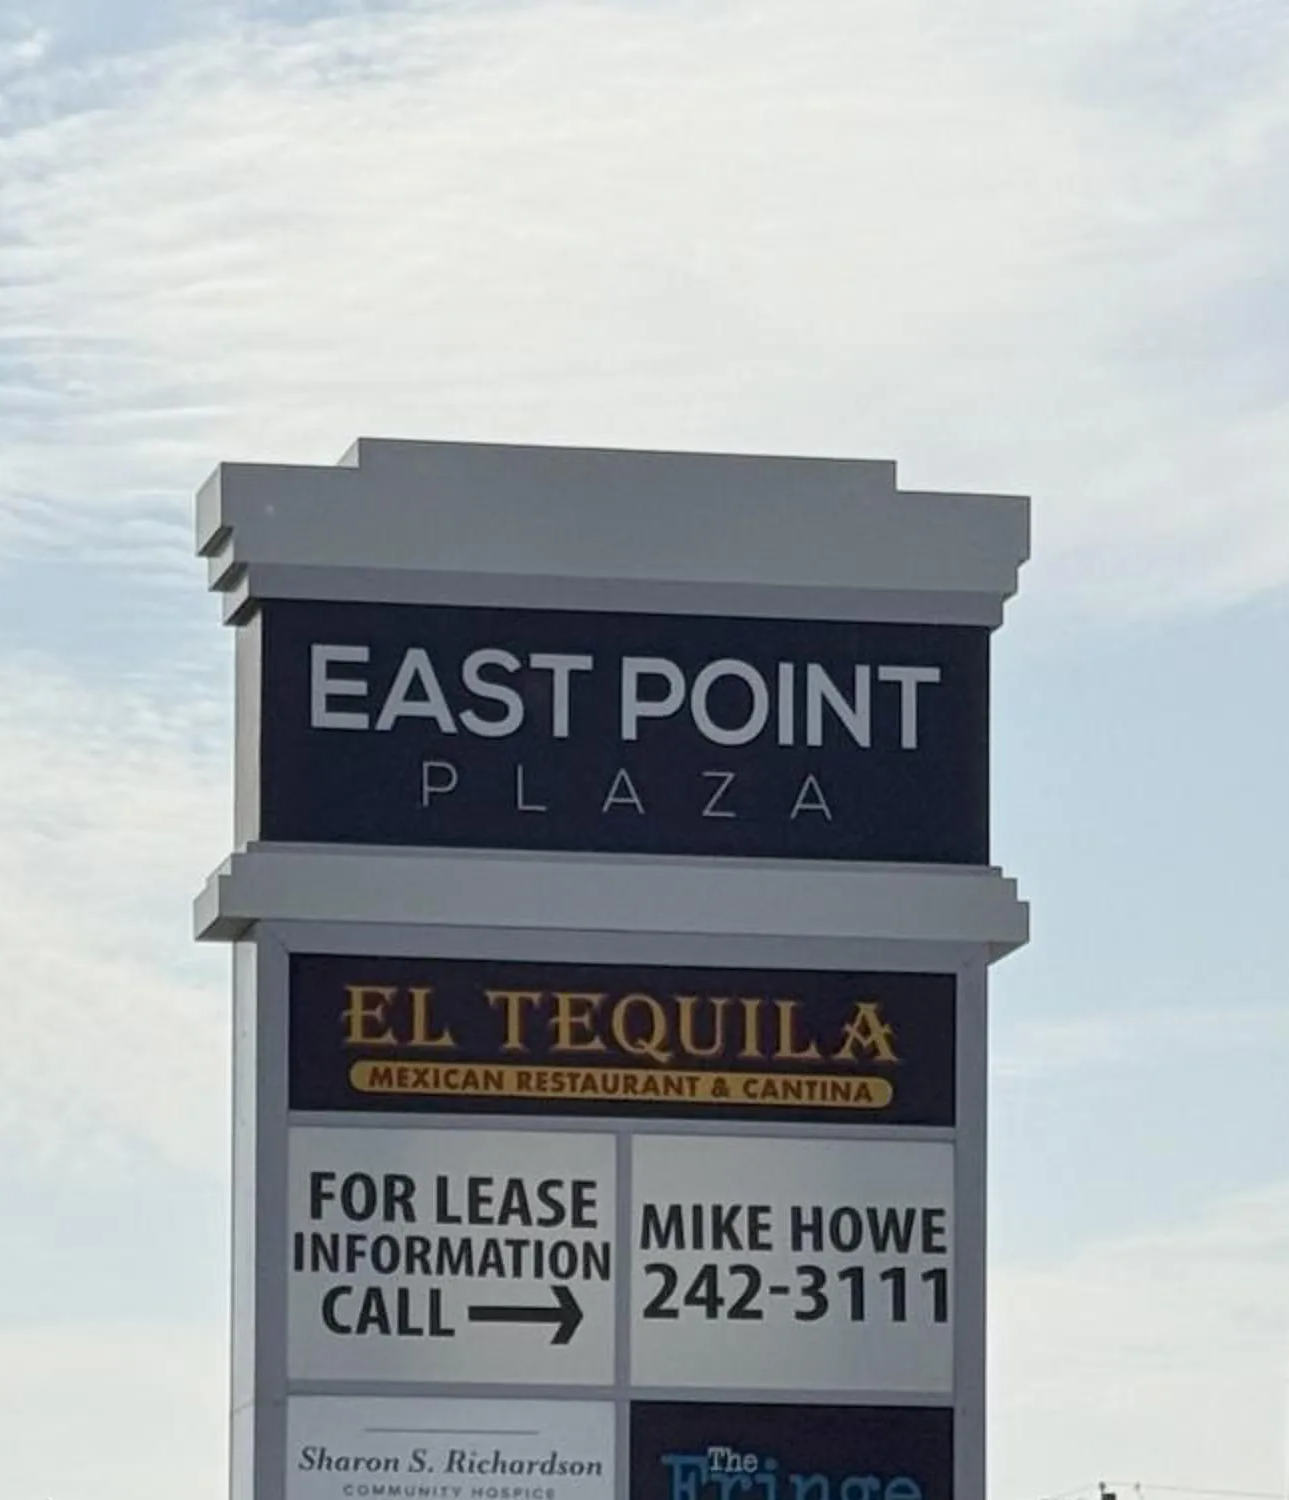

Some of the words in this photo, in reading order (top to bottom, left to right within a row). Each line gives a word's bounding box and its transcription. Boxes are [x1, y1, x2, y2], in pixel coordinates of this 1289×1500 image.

[310, 643, 594, 738] EAST
[620, 655, 941, 749] POINT
[421, 761, 833, 821] PLAZA
[341, 983, 457, 1051] EL
[486, 989, 905, 1064] TEQUILA
[368, 1066, 504, 1092] MEXICAN
[517, 1071, 698, 1098] RESTAURANT
[711, 1078, 730, 1098] &
[742, 1078, 873, 1103] CANTINA
[310, 1171, 417, 1223] FOR
[436, 1175, 598, 1229] LEASE
[640, 1203, 773, 1251] MIKE
[790, 1205, 948, 1254] HOWE
[293, 1231, 611, 1282] INFORMATION
[321, 1285, 456, 1337] CALL
[642, 1262, 948, 1323] 242-3111
[297, 1446, 399, 1473] Sharon
[407, 1449, 434, 1474] S.
[444, 1449, 604, 1477] Richardson
[707, 1446, 759, 1473] The
[342, 1484, 463, 1499] COMMUNITY
[471, 1487, 556, 1500] HOSPICE
